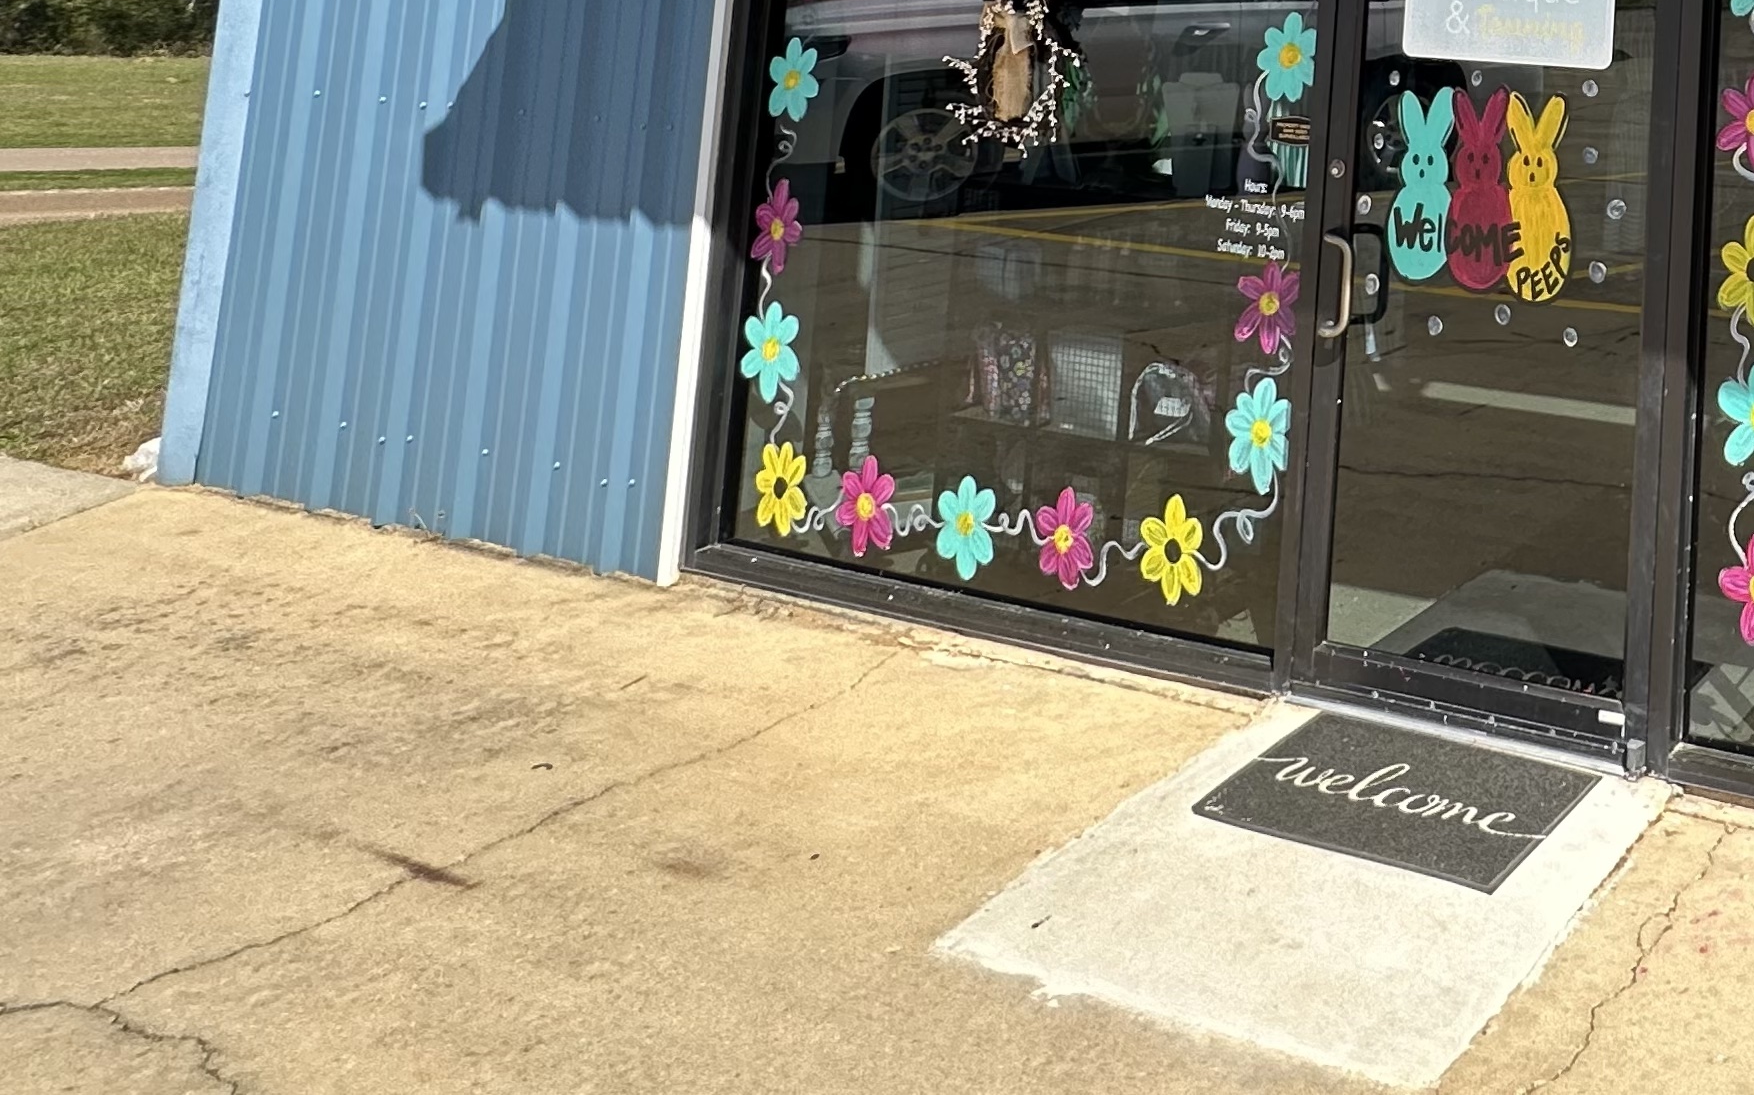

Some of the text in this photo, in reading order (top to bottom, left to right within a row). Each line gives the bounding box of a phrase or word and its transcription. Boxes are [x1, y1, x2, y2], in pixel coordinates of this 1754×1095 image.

[1446, 0, 1471, 35] &
[1205, 194, 1233, 214] Monday
[1257, 754, 1547, 840] welcome
